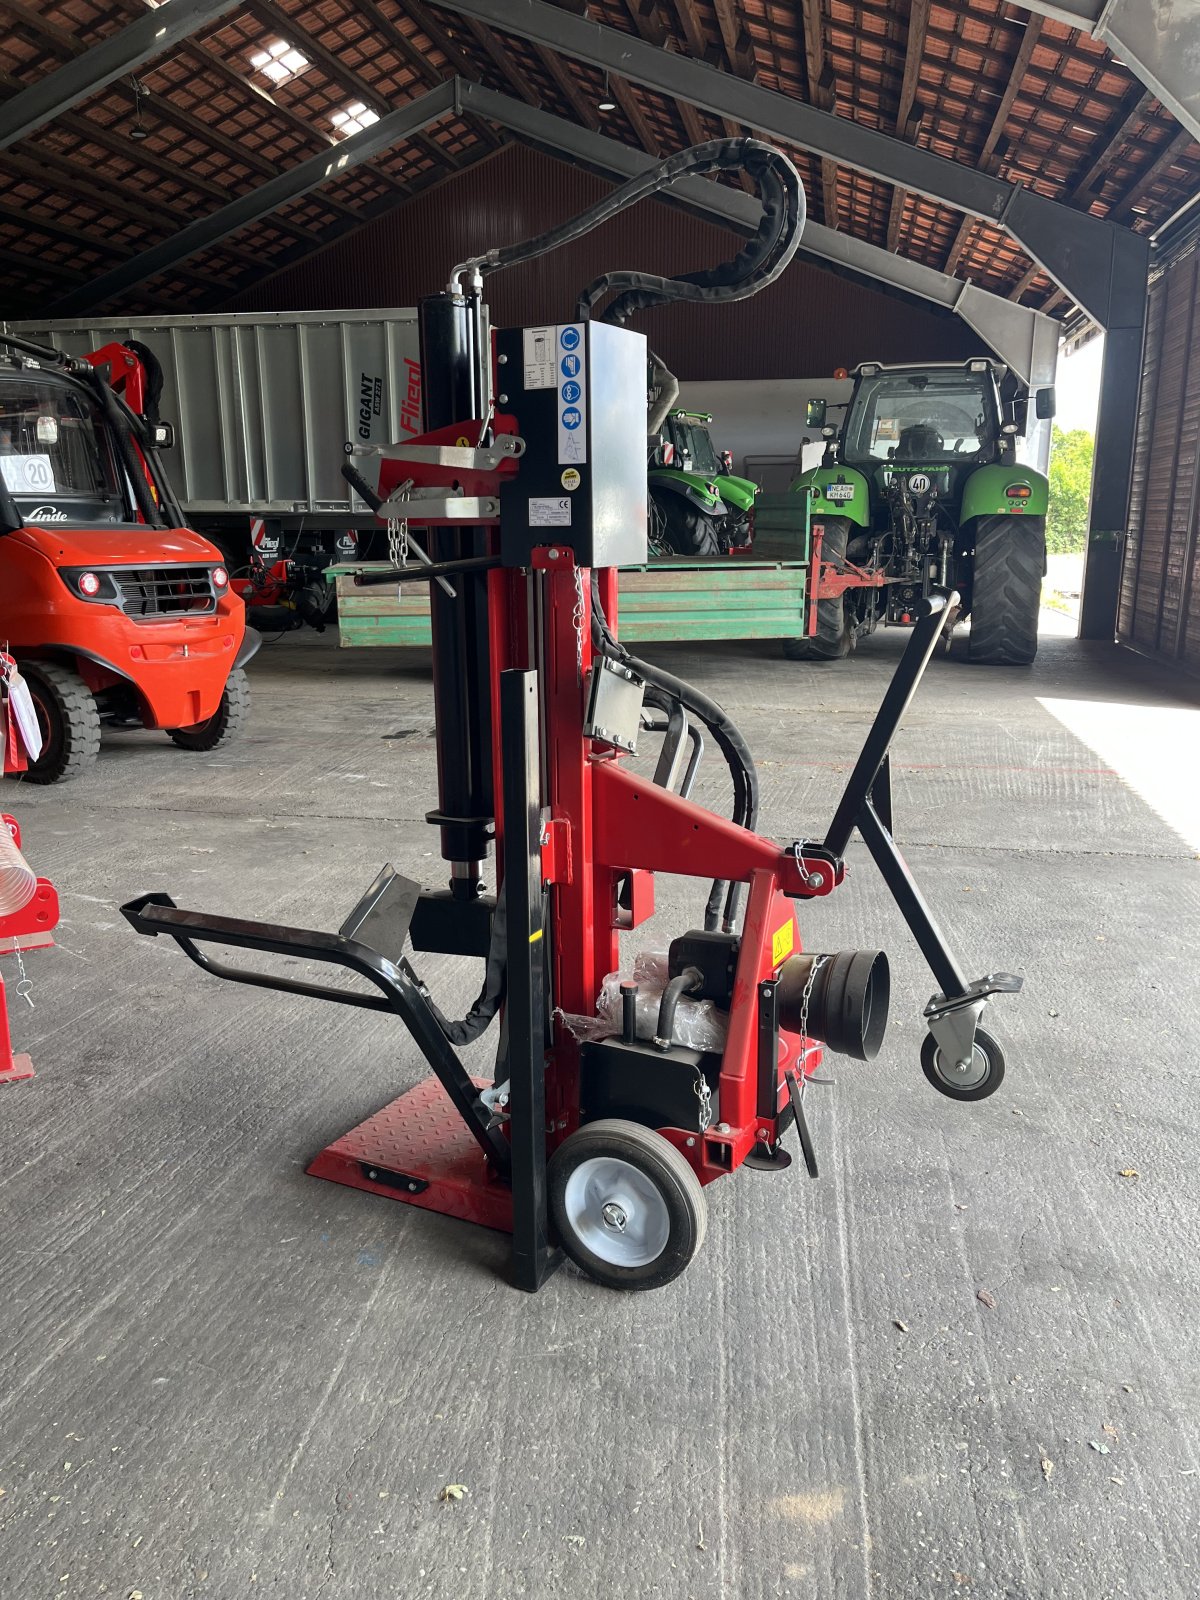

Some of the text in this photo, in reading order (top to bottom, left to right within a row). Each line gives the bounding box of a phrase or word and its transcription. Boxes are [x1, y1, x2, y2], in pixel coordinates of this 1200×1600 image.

[359, 372, 373, 439] GIGANT
[28, 463, 48, 484] 20
[912, 477, 926, 490] 40
[22, 505, 68, 522] Linde
